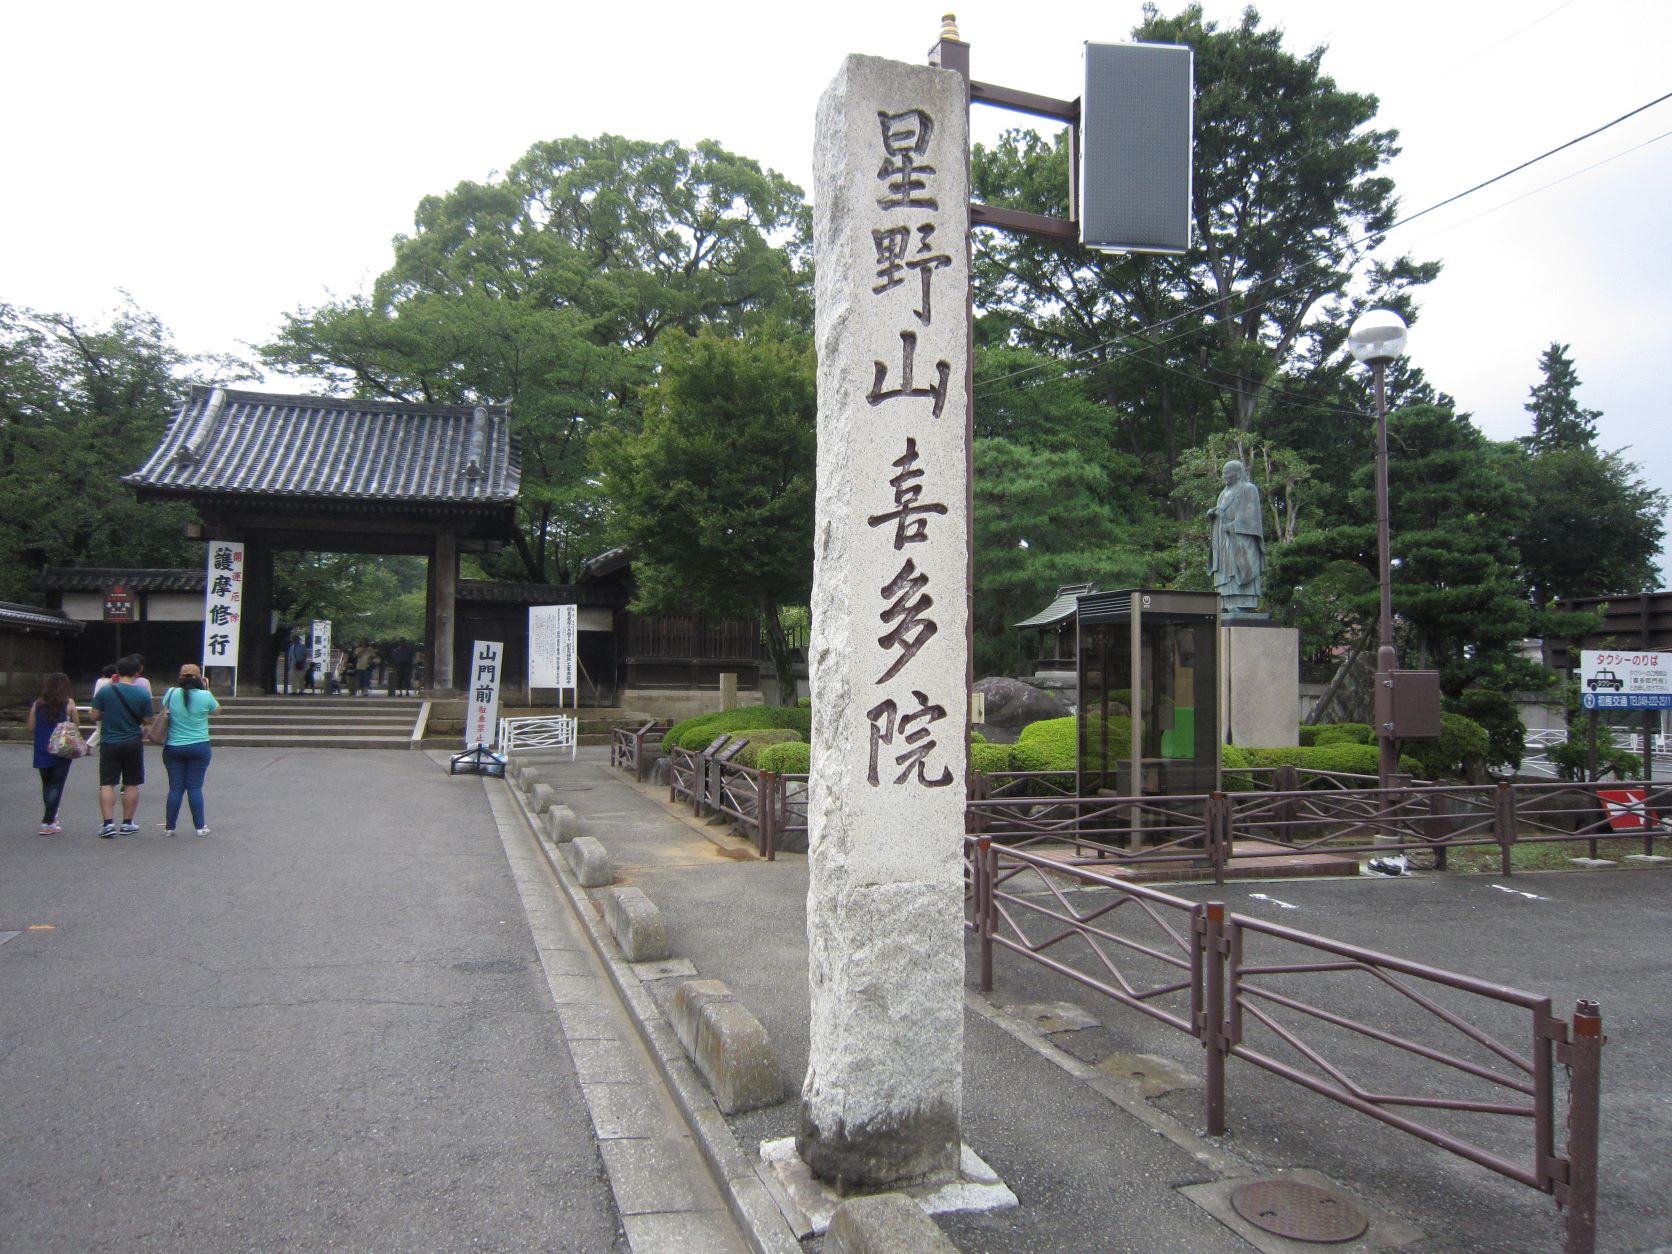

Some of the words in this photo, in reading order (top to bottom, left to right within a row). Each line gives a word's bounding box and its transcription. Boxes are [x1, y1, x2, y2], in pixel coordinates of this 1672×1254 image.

[867, 108, 954, 788] 星野山喜多院
[208, 547, 234, 656] 護摩修行
[230, 552, 243, 623] 開運厄除
[475, 645, 497, 704] 山門前
[1597, 654, 1658, 666] タクシーのりば
[475, 706, 487, 742] 駐車禁止
